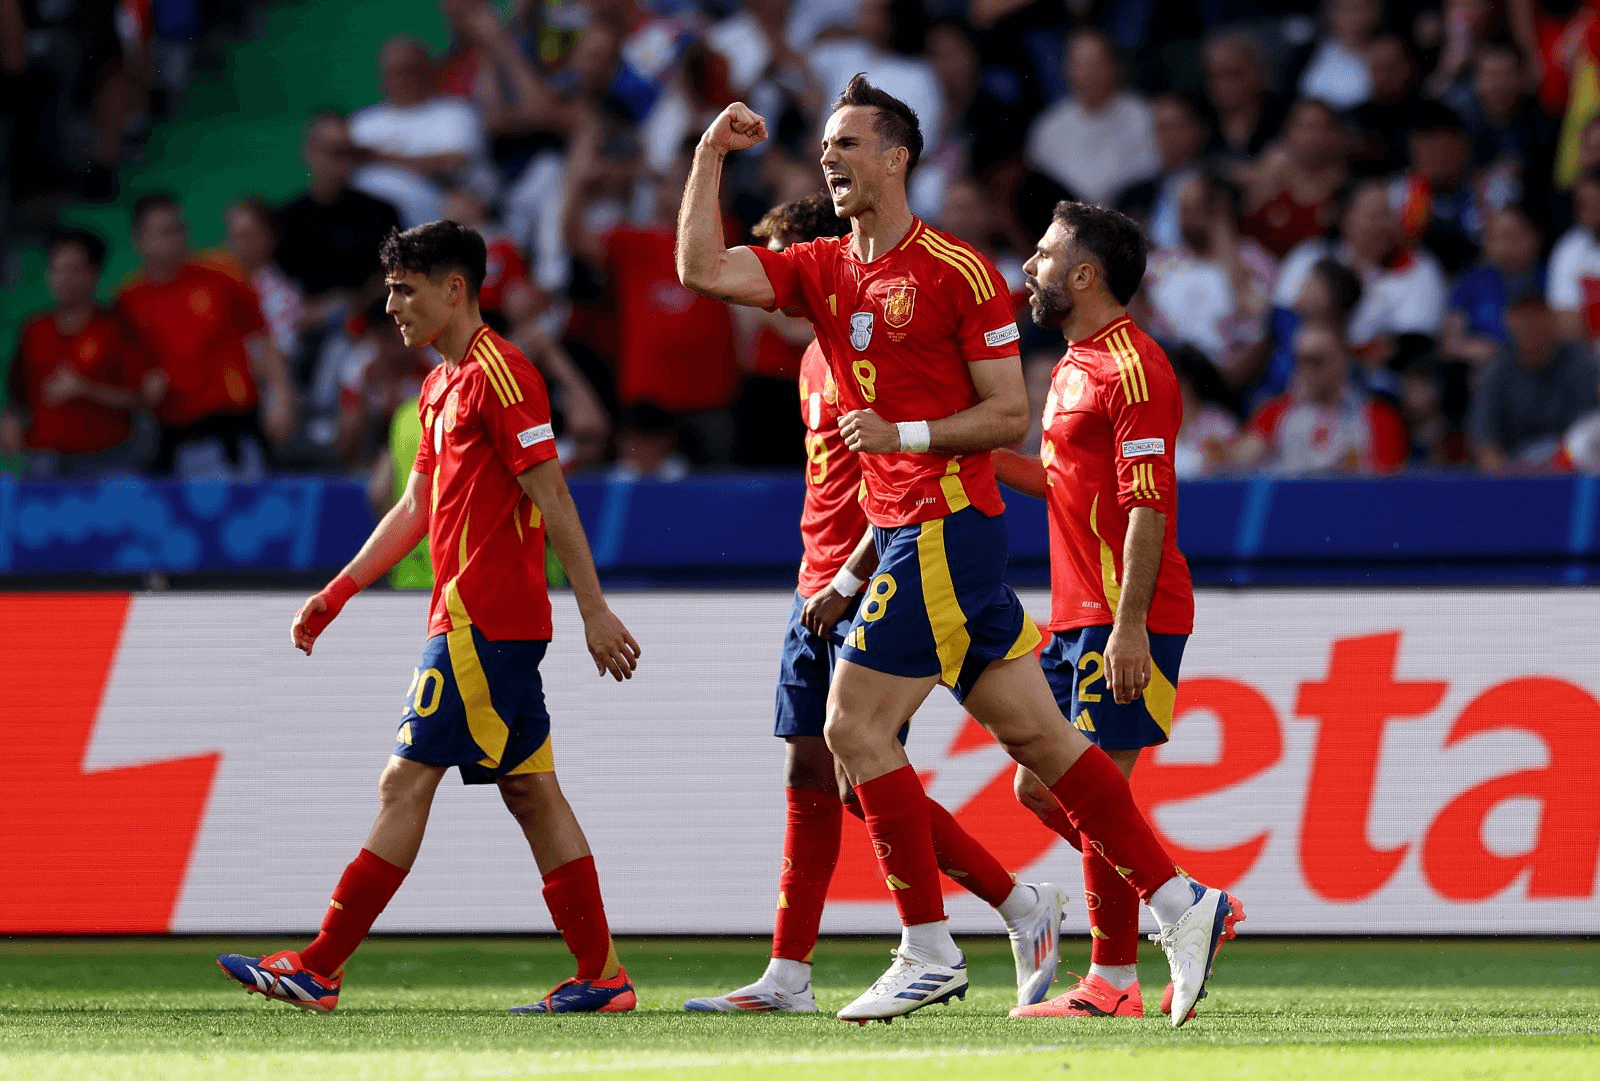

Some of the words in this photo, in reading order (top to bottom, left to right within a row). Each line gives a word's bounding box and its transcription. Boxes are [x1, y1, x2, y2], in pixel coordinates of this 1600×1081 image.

[806, 433, 829, 484] 19
[860, 573, 897, 622] 8
[1078, 650, 1105, 703] 2
